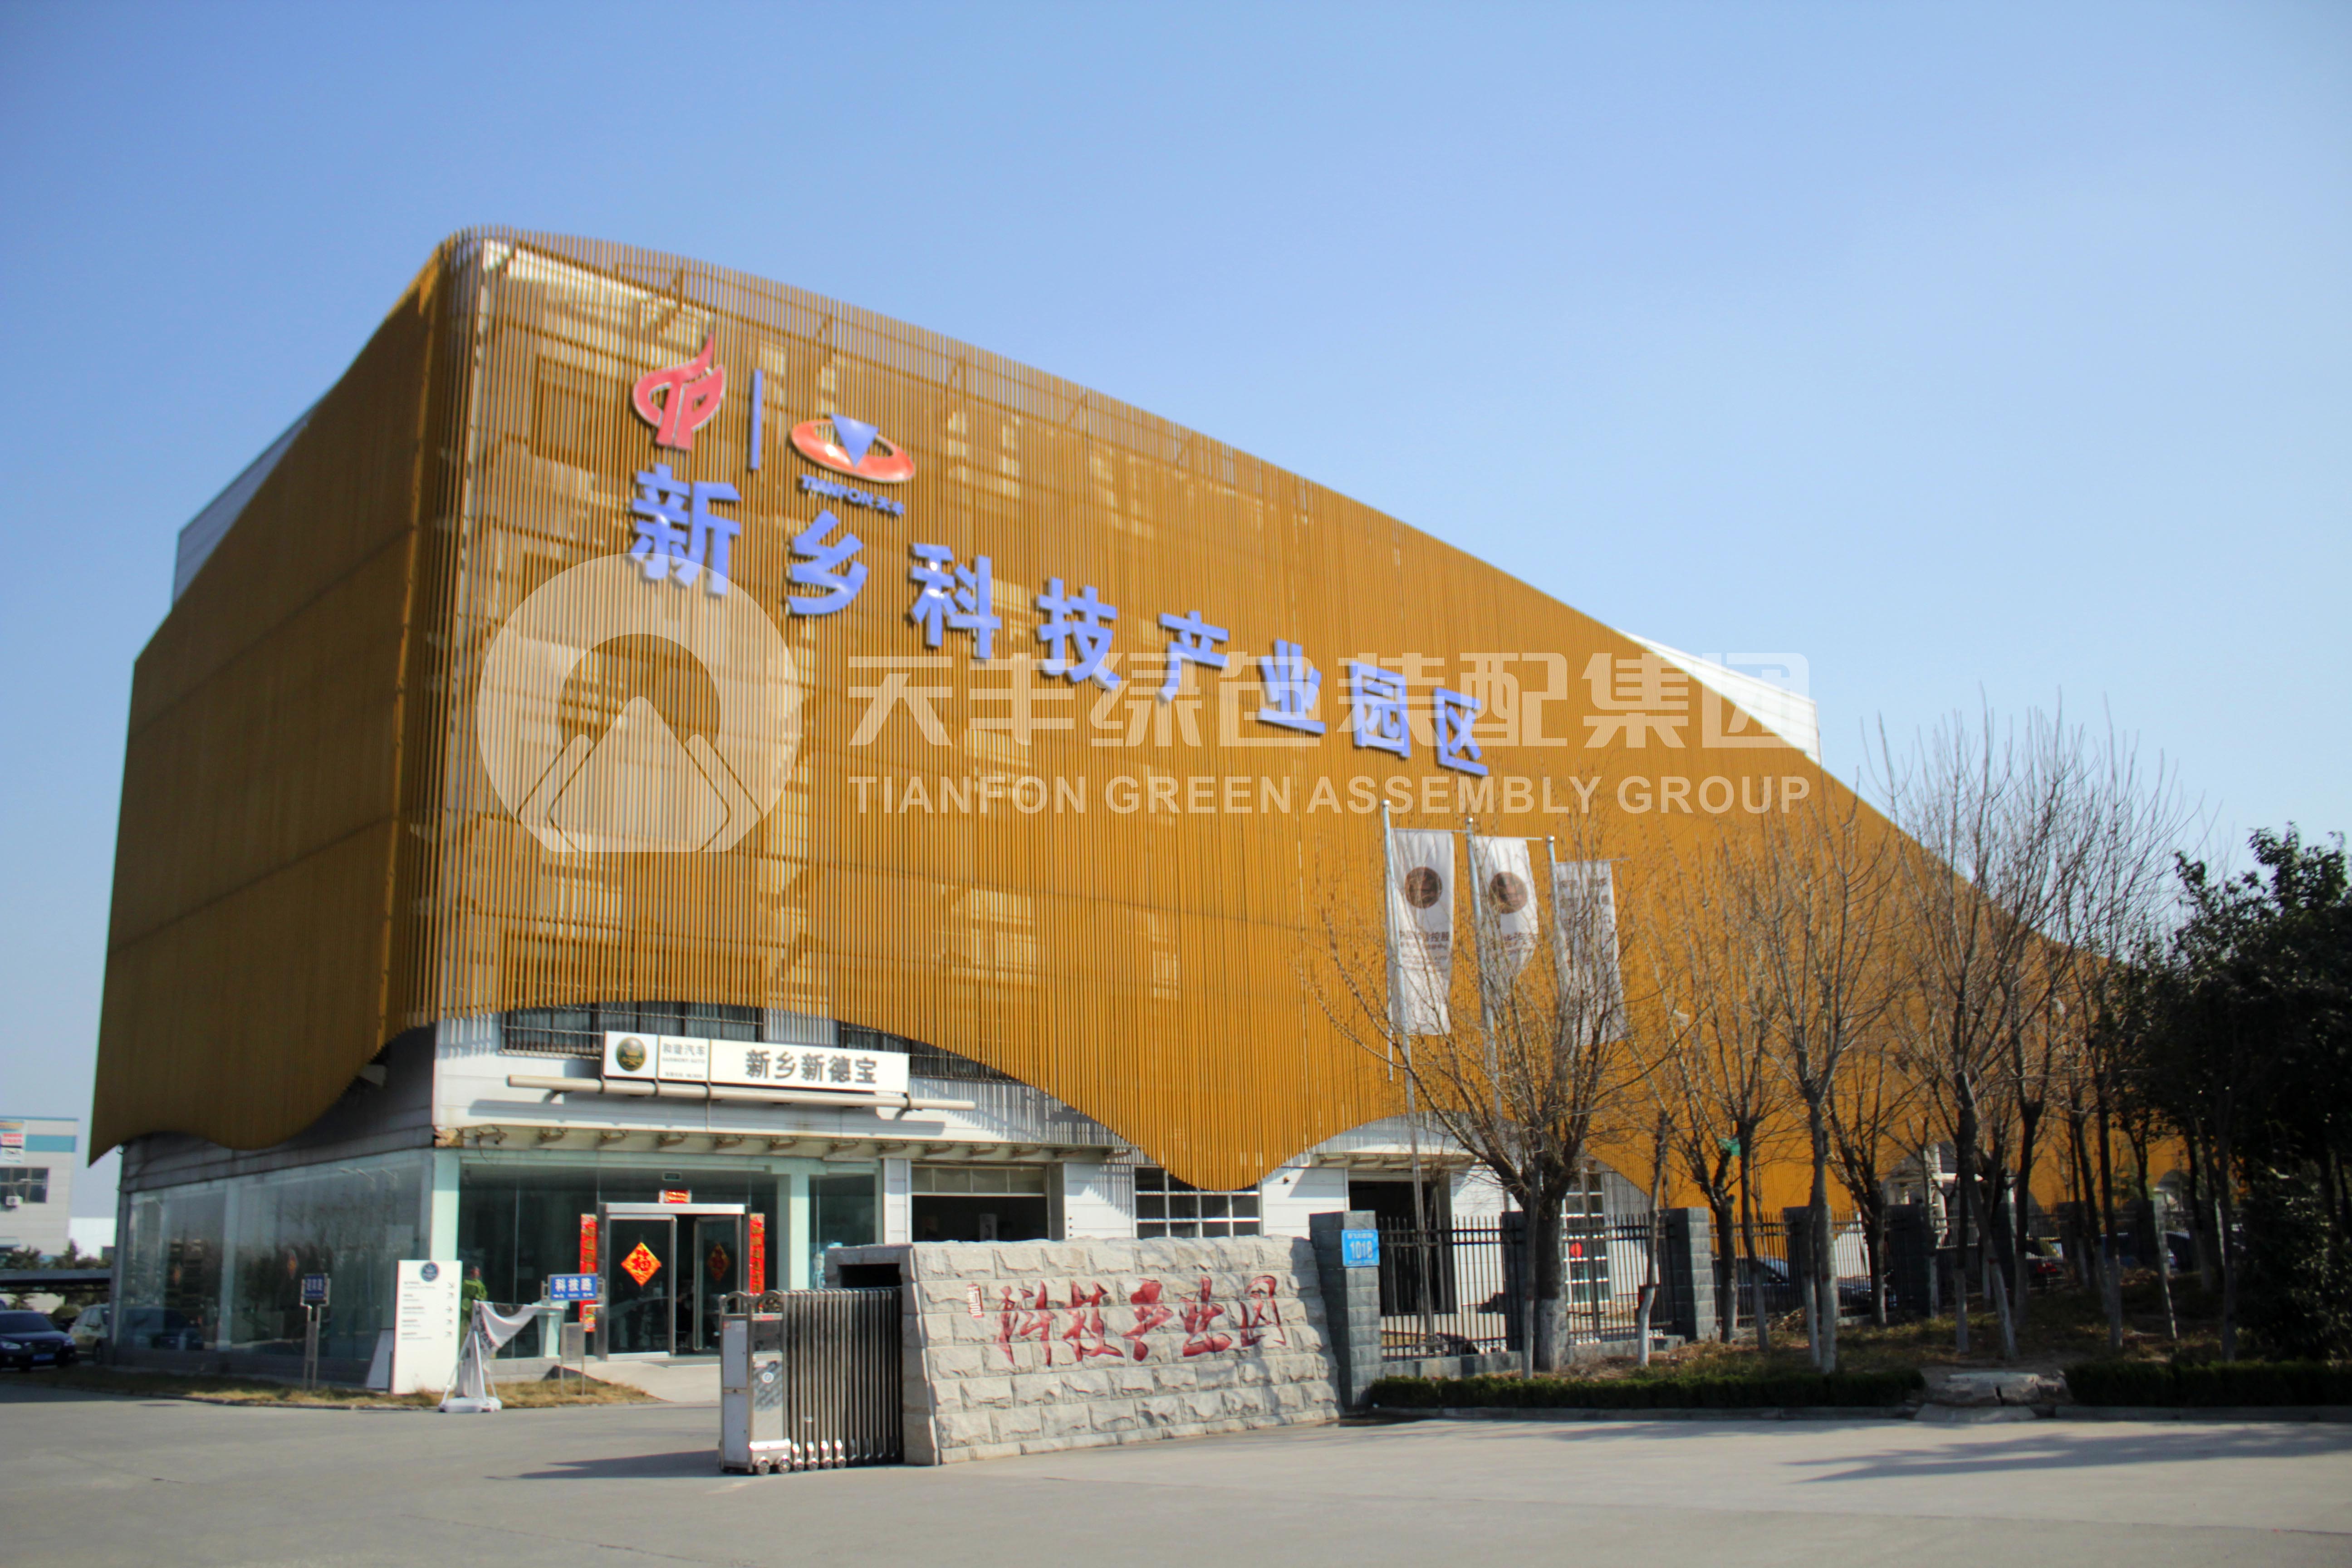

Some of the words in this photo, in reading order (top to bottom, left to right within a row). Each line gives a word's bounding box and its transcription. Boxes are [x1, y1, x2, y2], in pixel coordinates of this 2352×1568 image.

[630, 463, 1488, 776] 新乡科技产业园区
[746, 1049, 877, 1084] 新乡新德宝
